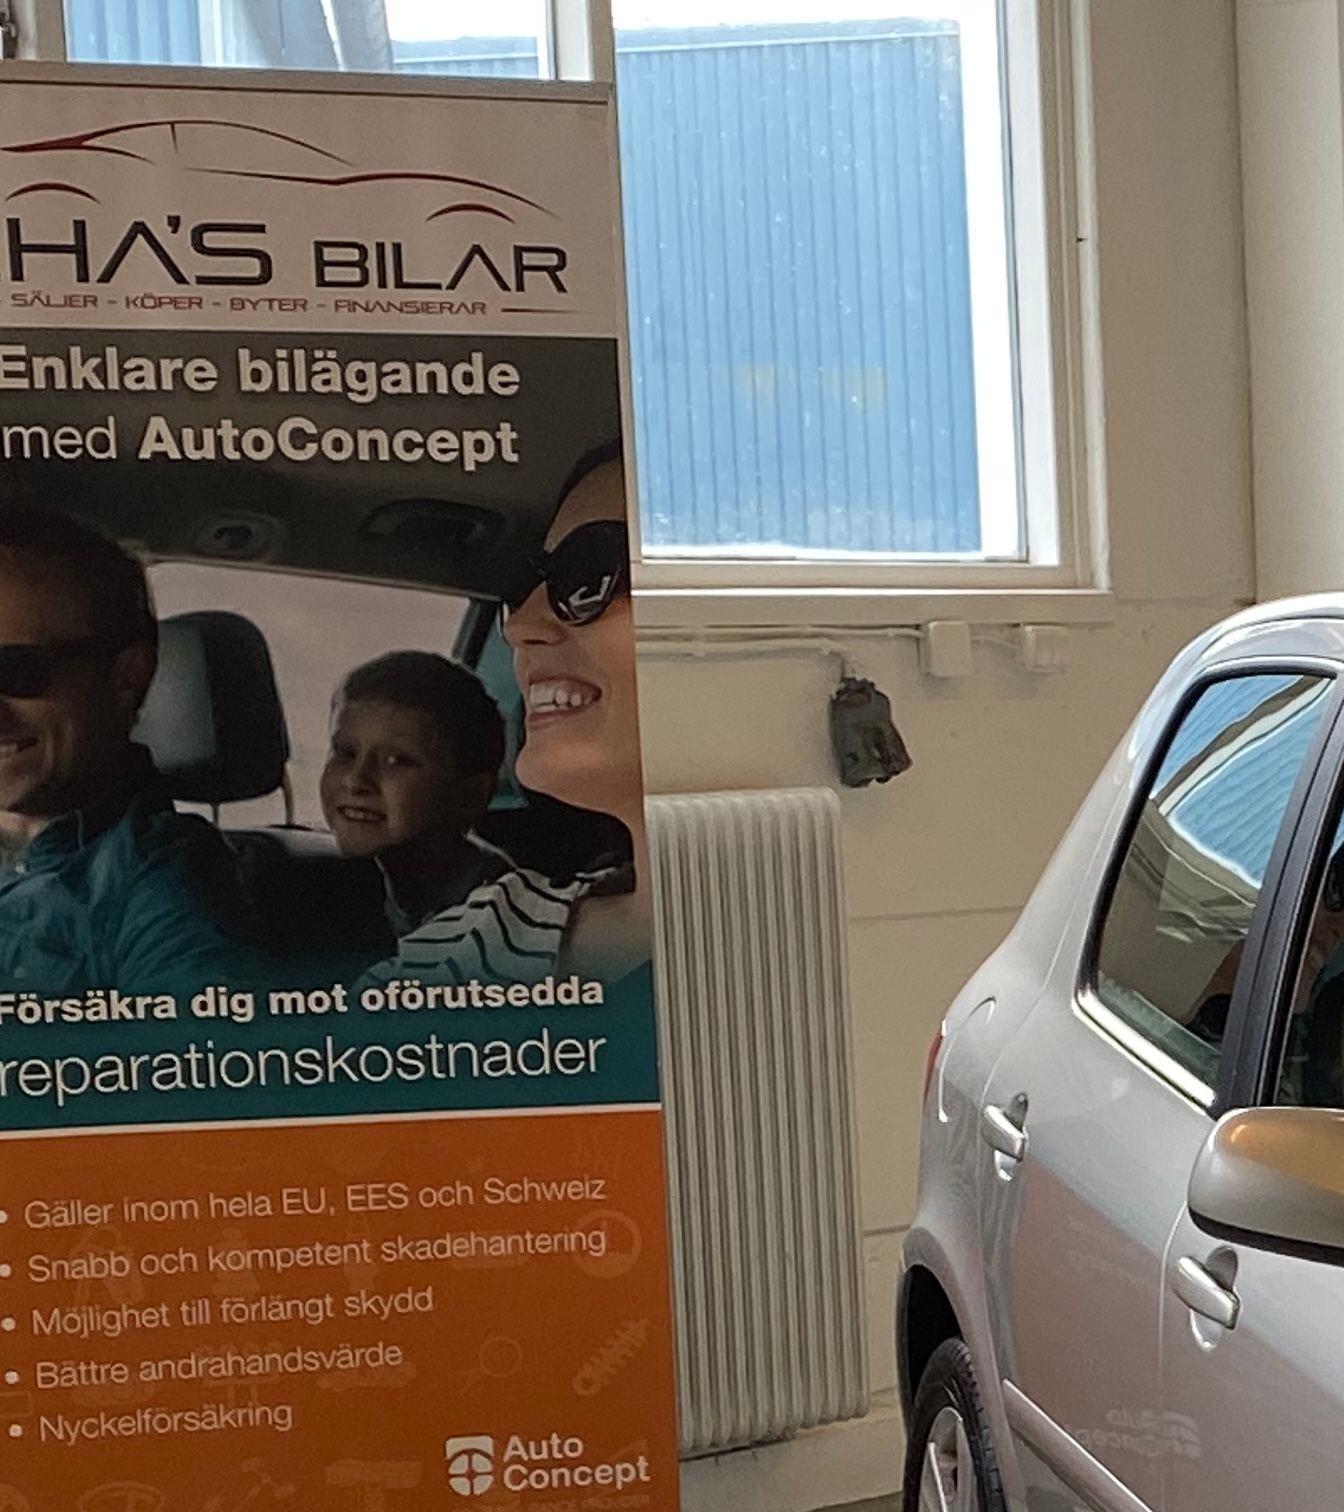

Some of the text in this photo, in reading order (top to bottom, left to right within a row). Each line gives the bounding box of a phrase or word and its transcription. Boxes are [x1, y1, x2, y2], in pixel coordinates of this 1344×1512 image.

[314, 240, 567, 293] BILAR
[11, 290, 486, 315] SÄLJER KÖPER BYTER FINANSIERAR
[0, 345, 520, 403] Enklare bilägande
[2, 415, 519, 471] med AutoConcept
[0, 976, 603, 1025] Försäkra dig mot oförutsedda
[0, 1027, 607, 1107] reparationskostnader
[24, 1174, 607, 1229] Gäller inom hela EU, EES och Schweiz
[28, 1226, 607, 1283] Snabb och kompetent skadehantering
[32, 1285, 434, 1339] Möjlighet till förlängt skydd
[36, 1341, 403, 1389] Bättre andrahandsvärde
[40, 1402, 293, 1446] Nyckelförsäkring
[503, 1432, 584, 1462] Auto
[503, 1456, 651, 1491] Concept
